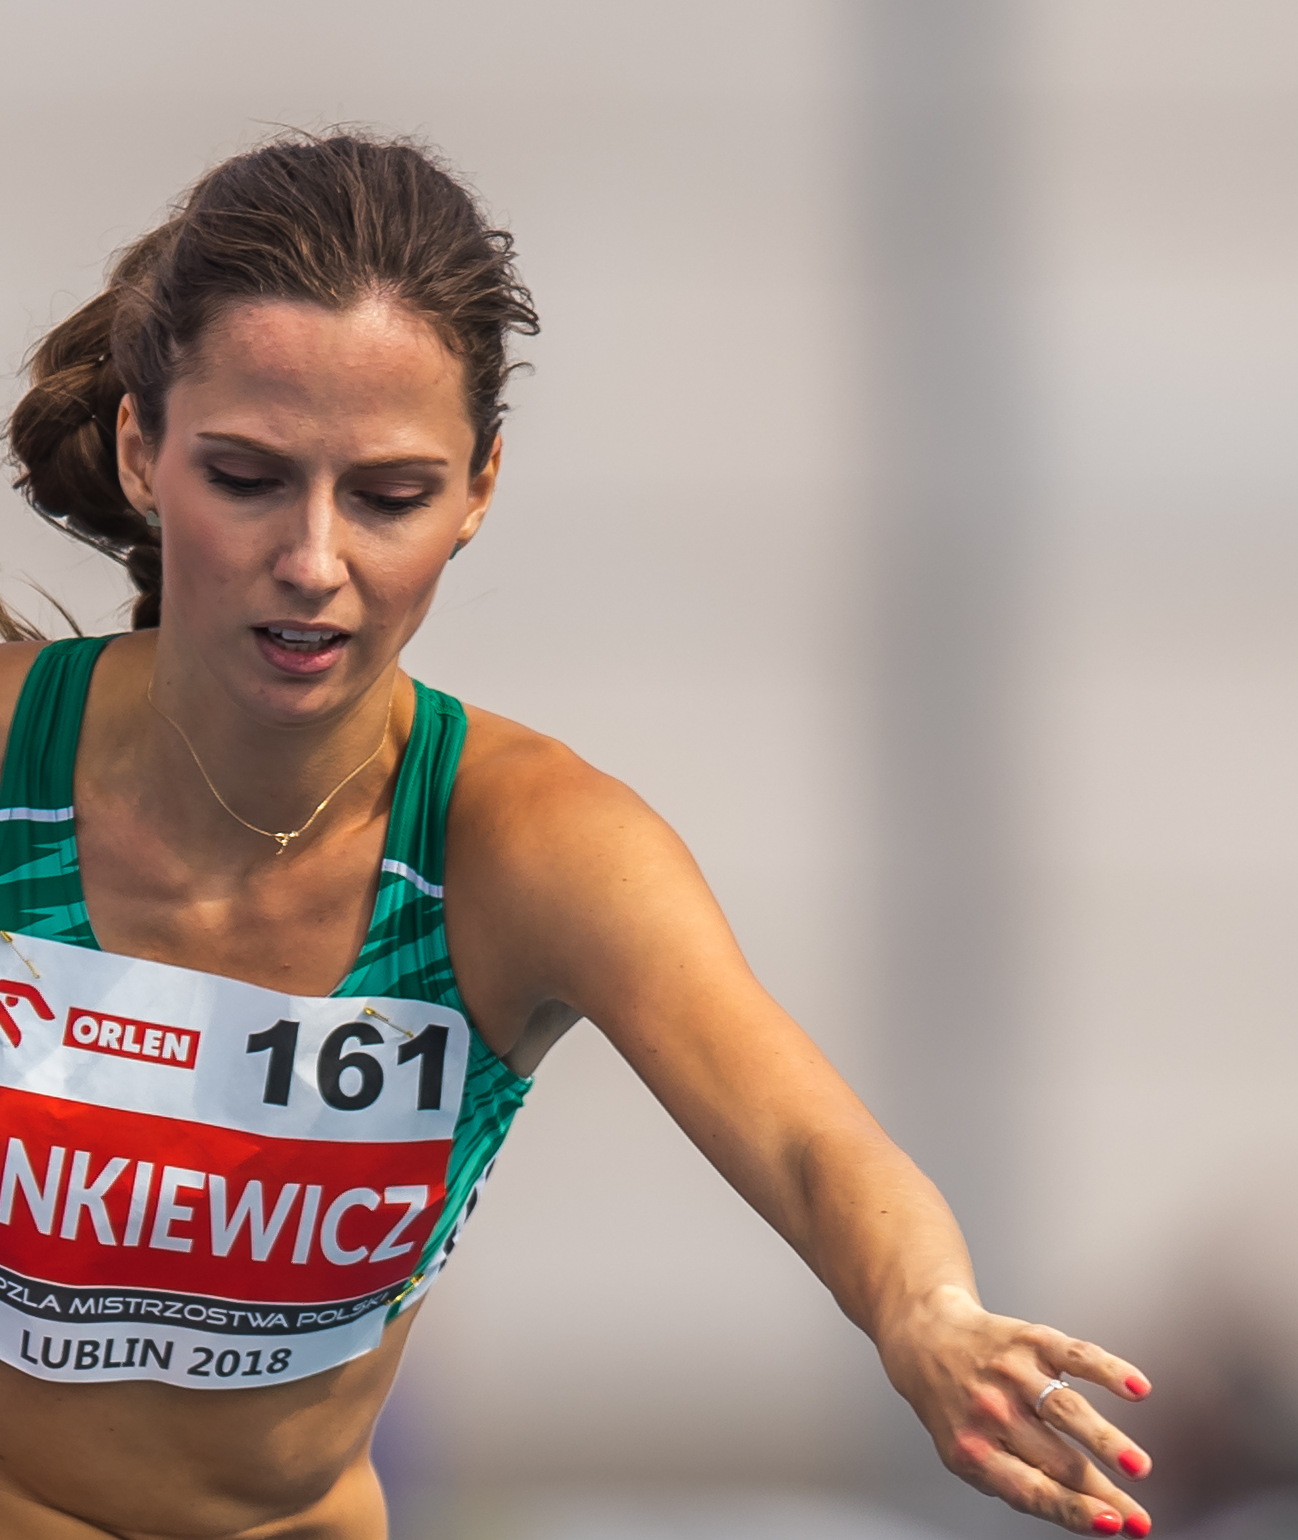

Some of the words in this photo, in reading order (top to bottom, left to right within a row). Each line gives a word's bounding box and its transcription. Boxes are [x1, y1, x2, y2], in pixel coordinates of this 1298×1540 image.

[71, 1015, 192, 1063] ORLEN
[245, 1019, 450, 1111] 161
[68, 1297, 289, 1329] MISTRZOSTWA
[20, 1329, 174, 1371] LUBLIN
[186, 1347, 292, 1378] 2018
